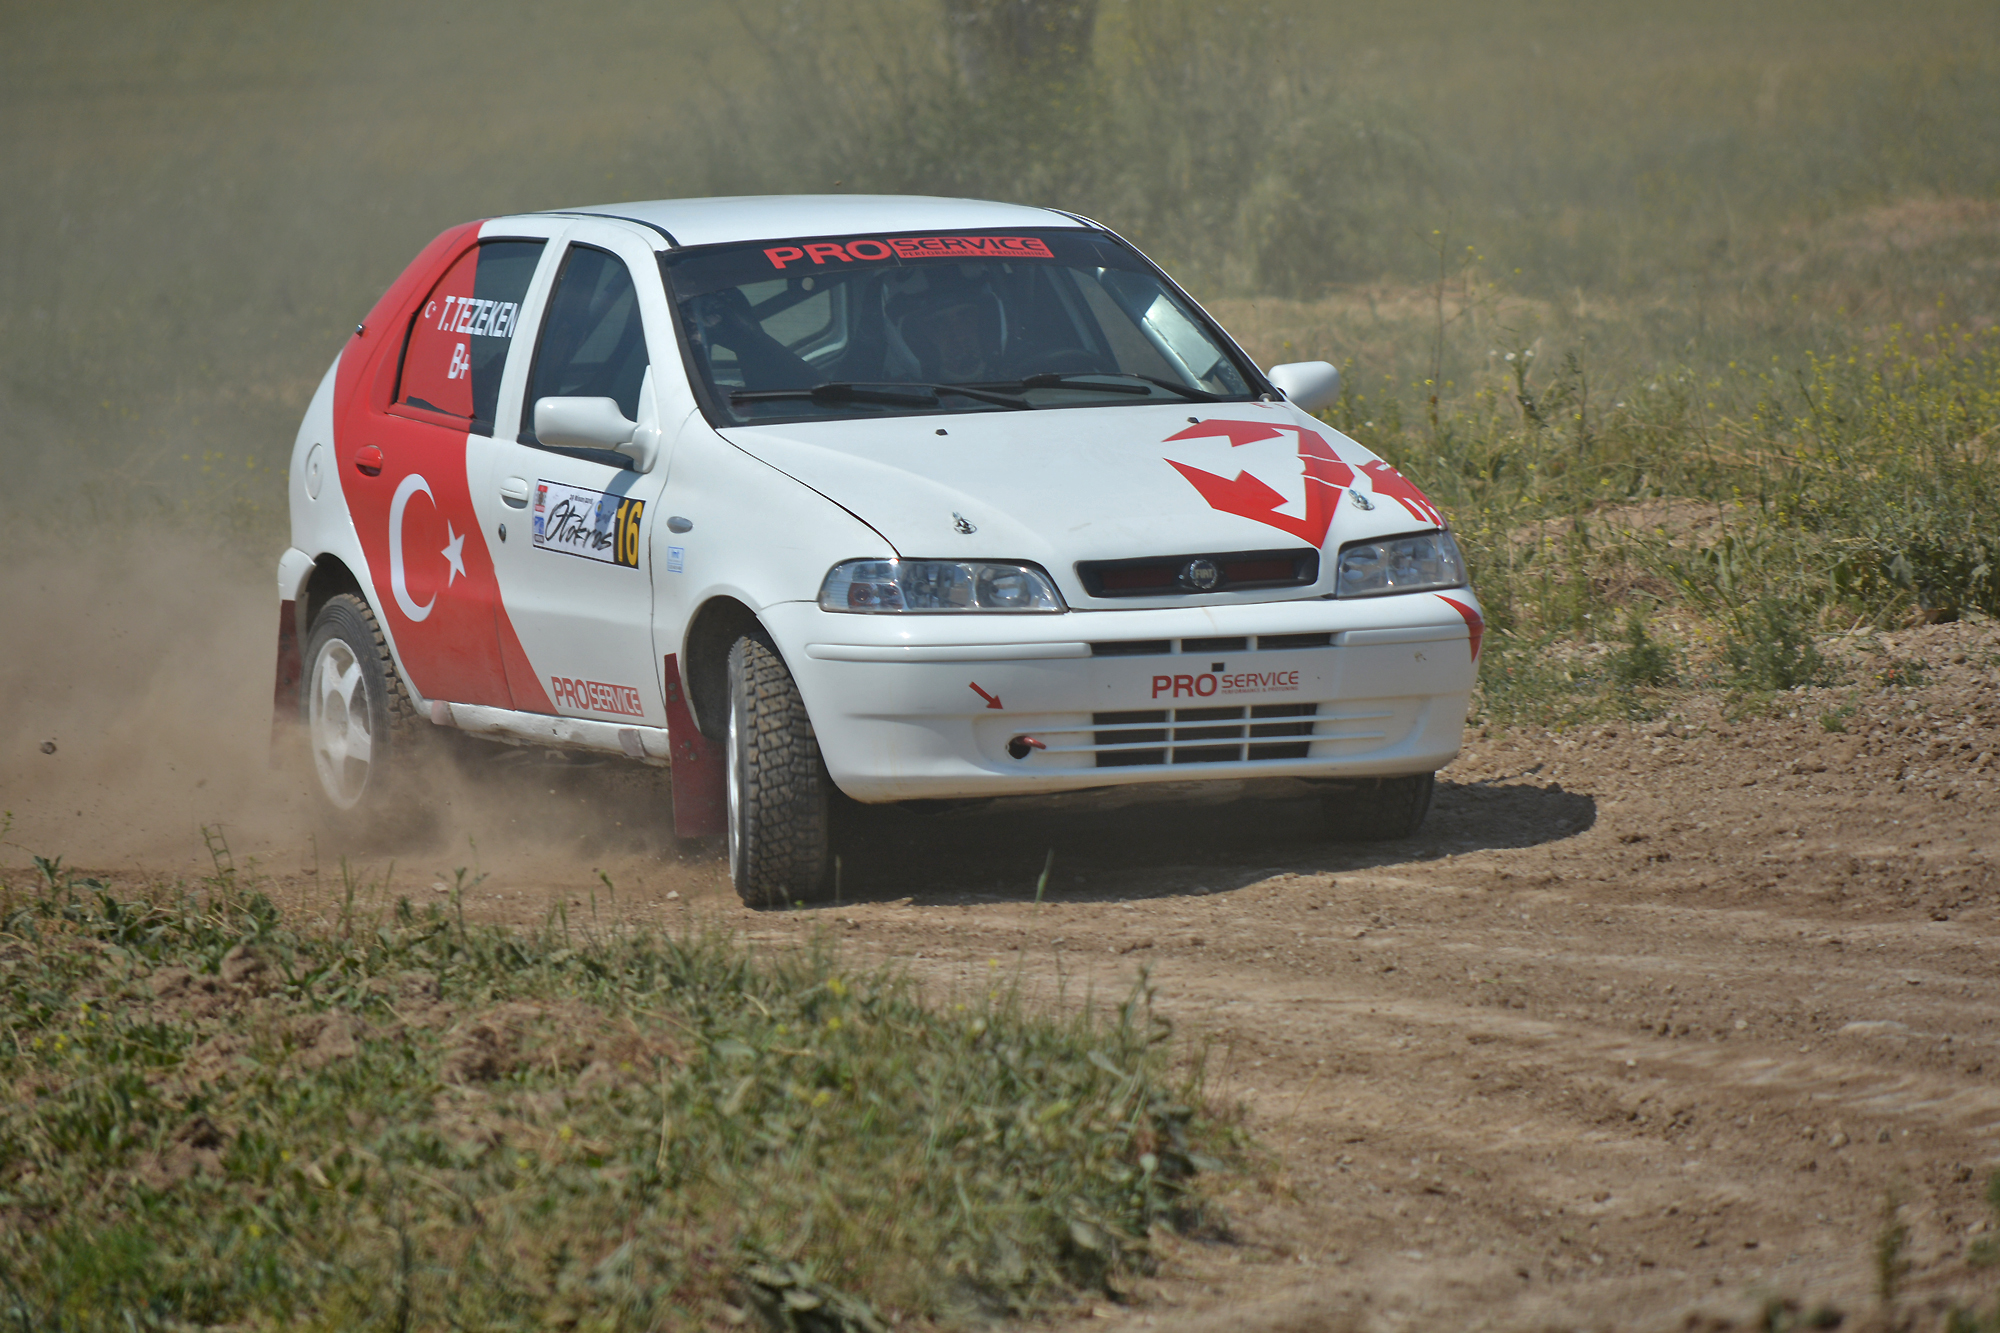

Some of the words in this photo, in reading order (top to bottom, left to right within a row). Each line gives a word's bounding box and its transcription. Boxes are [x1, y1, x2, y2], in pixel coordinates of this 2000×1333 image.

[763, 240, 892, 269] PRO
[893, 238, 1045, 251] SERVICE
[437, 295, 519, 338] T.TEZEKEN
[447, 342, 470, 380] B+
[616, 499, 644, 566] 16
[1194, 568, 1213, 579] FIAT
[551, 676, 590, 710] PRO
[588, 684, 642, 715] SERVICE
[1152, 673, 1217, 699] PRO
[1221, 670, 1299, 689] SERVICE
